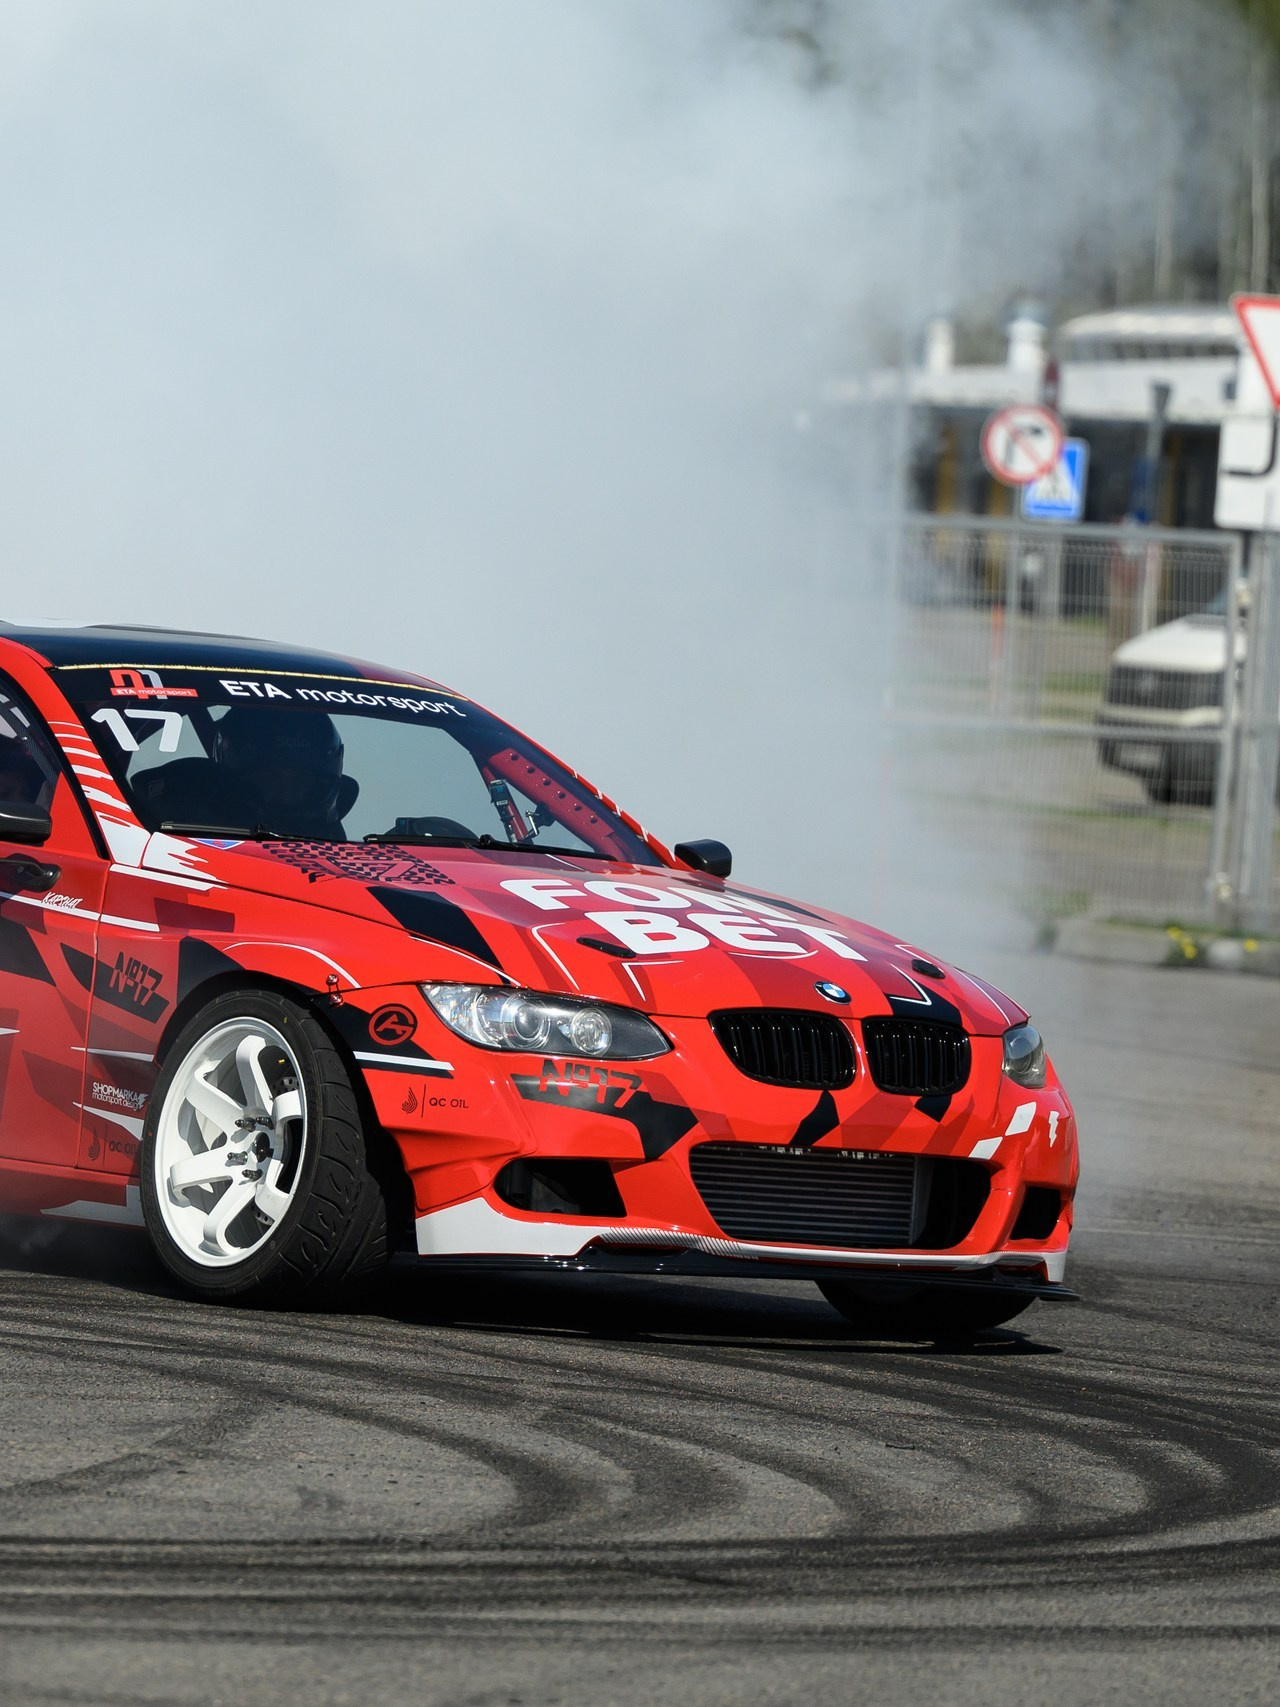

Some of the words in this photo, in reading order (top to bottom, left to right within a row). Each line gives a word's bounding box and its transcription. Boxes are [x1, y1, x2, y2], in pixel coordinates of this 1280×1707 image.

[218, 680, 292, 699] ETA
[296, 688, 467, 717] motorsport
[91, 708, 183, 752] 17
[499, 879, 798, 921] FON
[583, 911, 868, 962] BET
[93, 1082, 138, 1102] SHOPMARKA
[429, 1097, 447, 1107] QC
[450, 1099, 469, 1109] OIL
